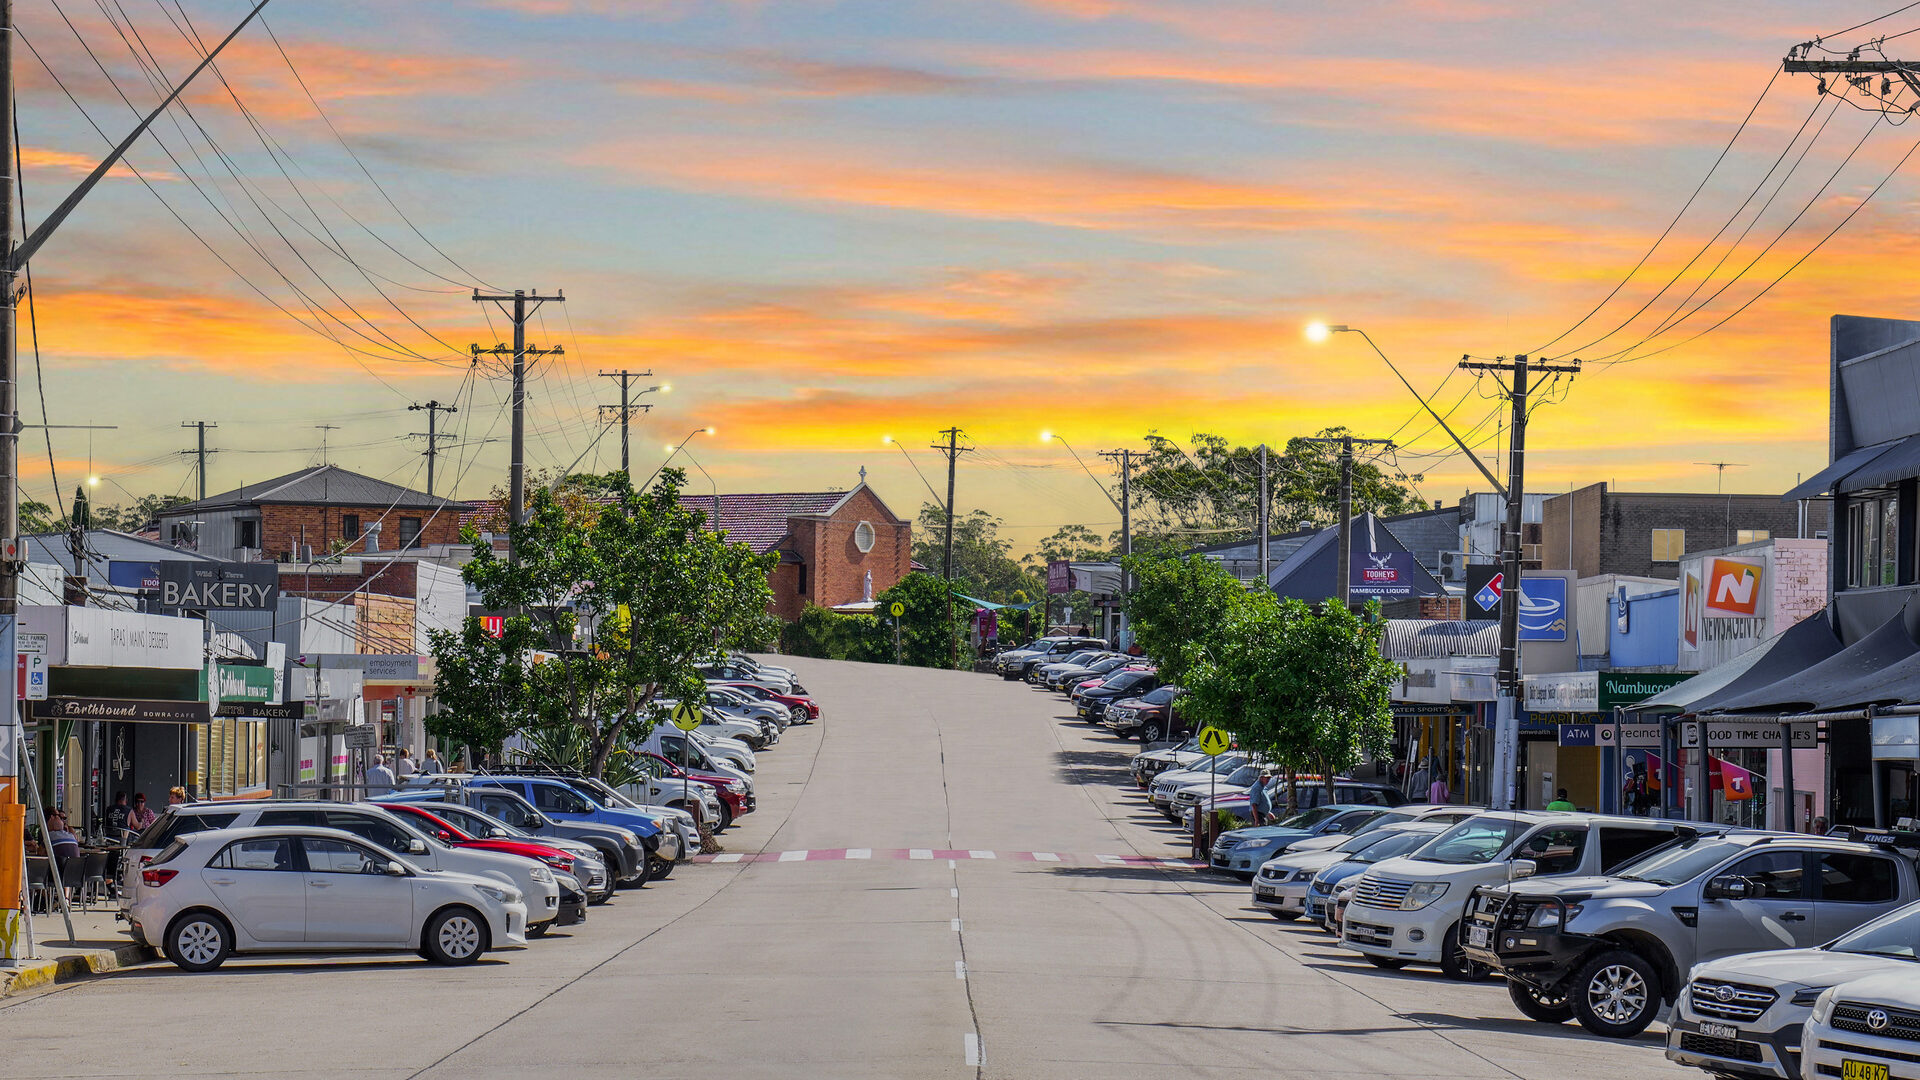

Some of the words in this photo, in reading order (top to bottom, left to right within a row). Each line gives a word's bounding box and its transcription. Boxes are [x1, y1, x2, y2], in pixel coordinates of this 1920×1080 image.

[1366, 570, 1395, 578] TOOHEYS
[163, 581, 273, 608] BAKERY
[110, 628, 126, 647] TAPAS
[129, 631, 145, 648] MAINS
[369, 660, 412, 668] employment
[369, 667, 397, 675] services
[65, 701, 137, 716] Earthbound
[252, 709, 291, 717] BAKERY
[1531, 713, 1606, 725] PHARMACY
[1566, 729, 1589, 739] ATM
[1706, 730, 1732, 740] OOD
[1736, 730, 1760, 740] TIME
[1762, 730, 1811, 741] CHAIE'S
[1864, 834, 1896, 844] KINGS
